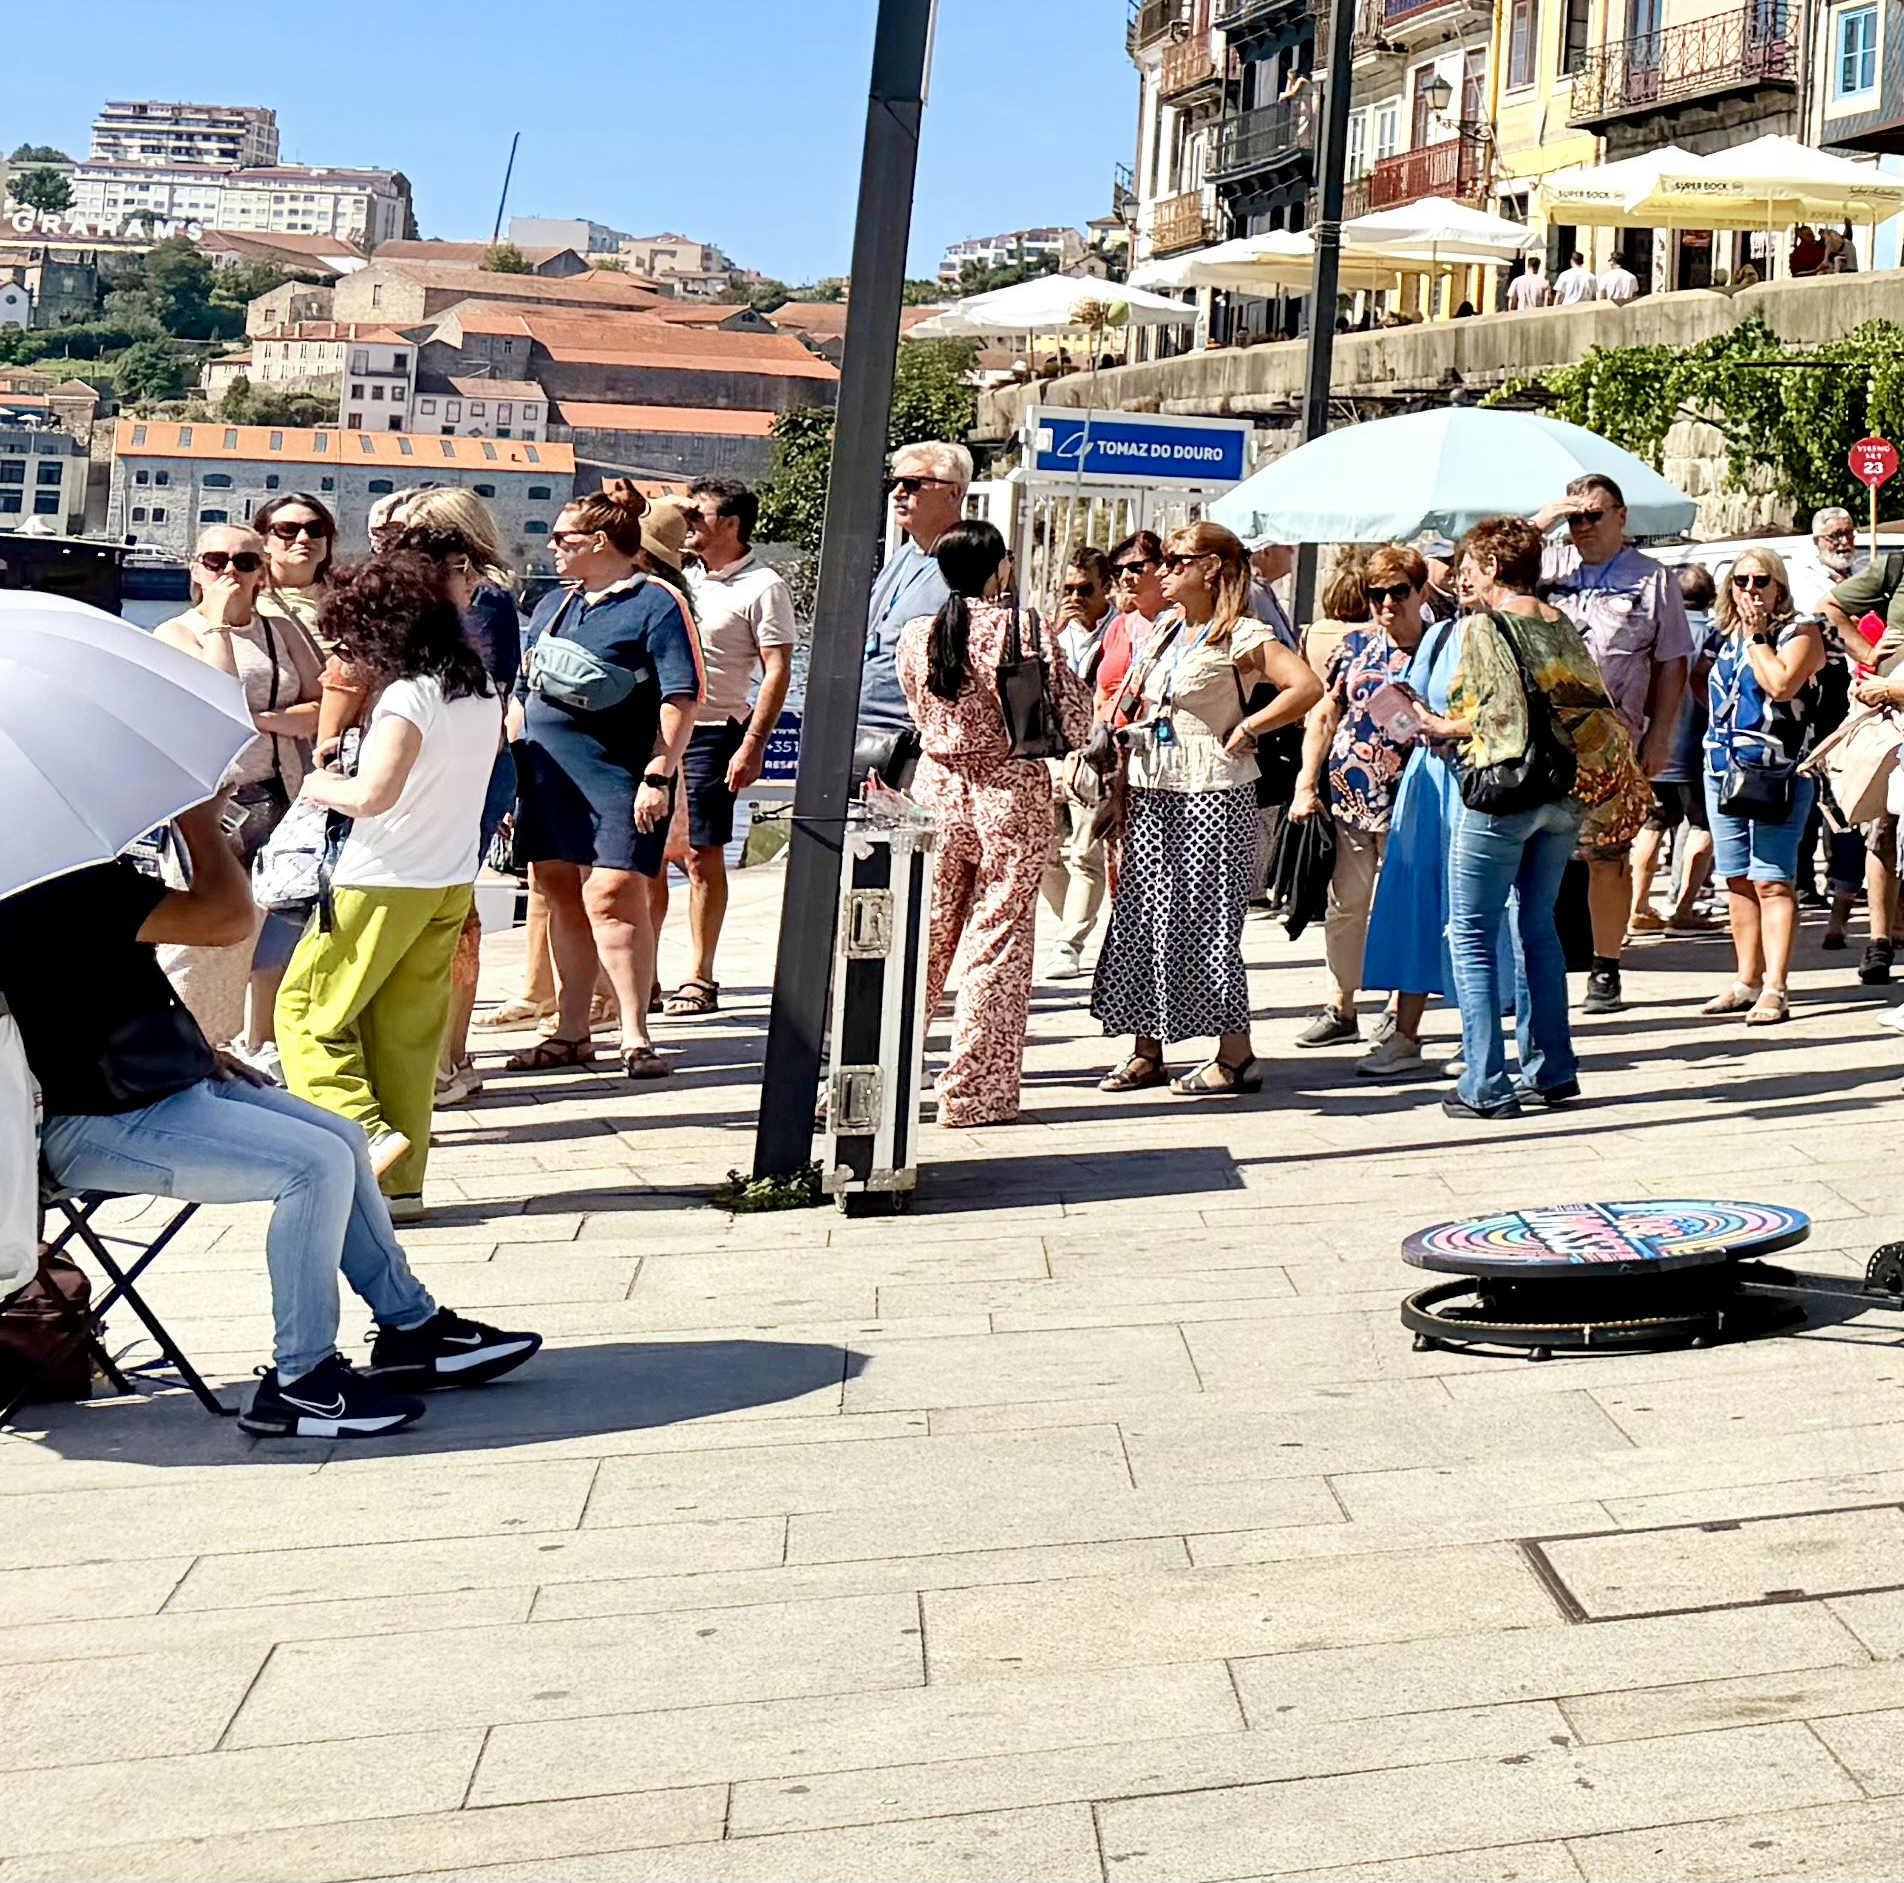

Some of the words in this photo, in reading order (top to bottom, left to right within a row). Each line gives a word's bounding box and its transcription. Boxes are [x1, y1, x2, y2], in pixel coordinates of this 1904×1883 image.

[1704, 182, 1728, 190] BOCK
[11, 211, 203, 241] GRAHAM'S
[1097, 440, 1148, 458] TOMAZ
[1150, 443, 1171, 458] DO
[1173, 445, 1223, 461] DOURO
[1863, 461, 1884, 475] 23
